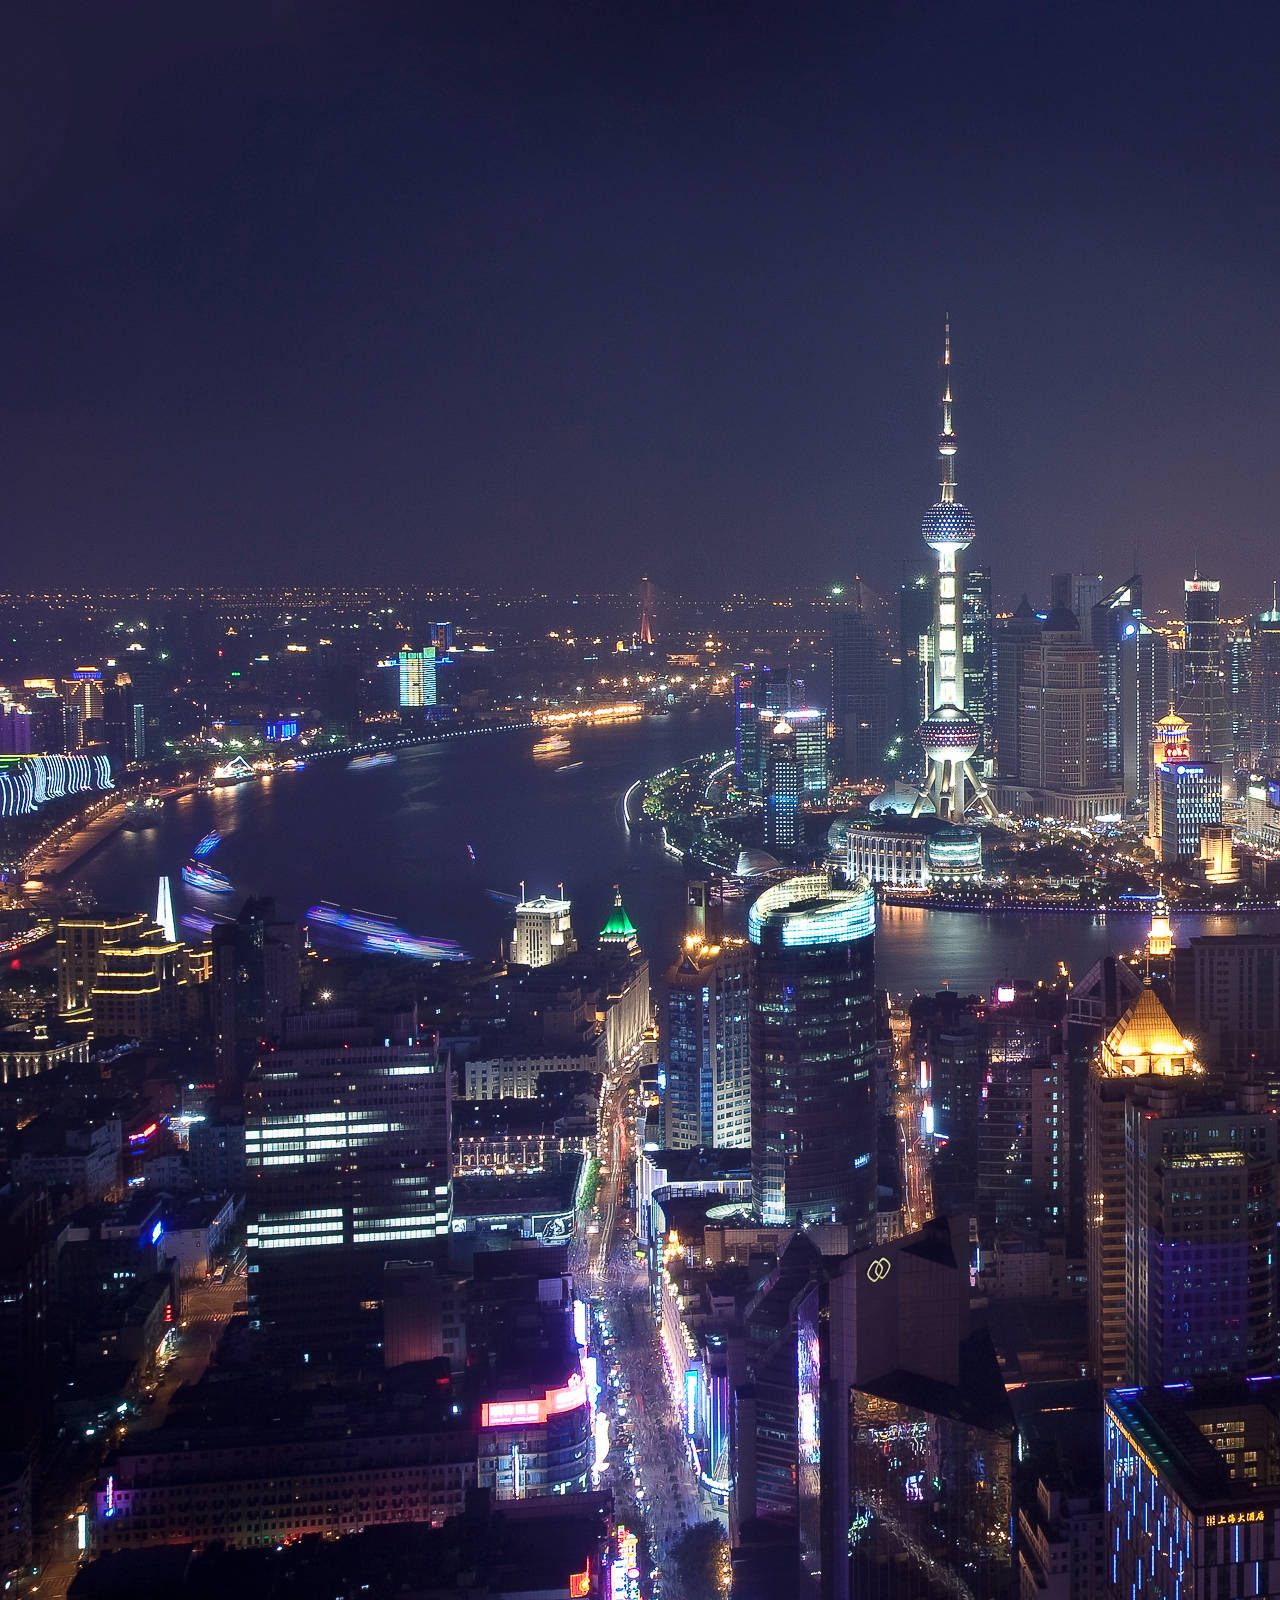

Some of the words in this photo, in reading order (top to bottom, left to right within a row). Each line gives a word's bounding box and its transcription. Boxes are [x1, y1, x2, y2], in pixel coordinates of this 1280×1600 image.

[1217, 1510, 1265, 1526] 上海大酒店
